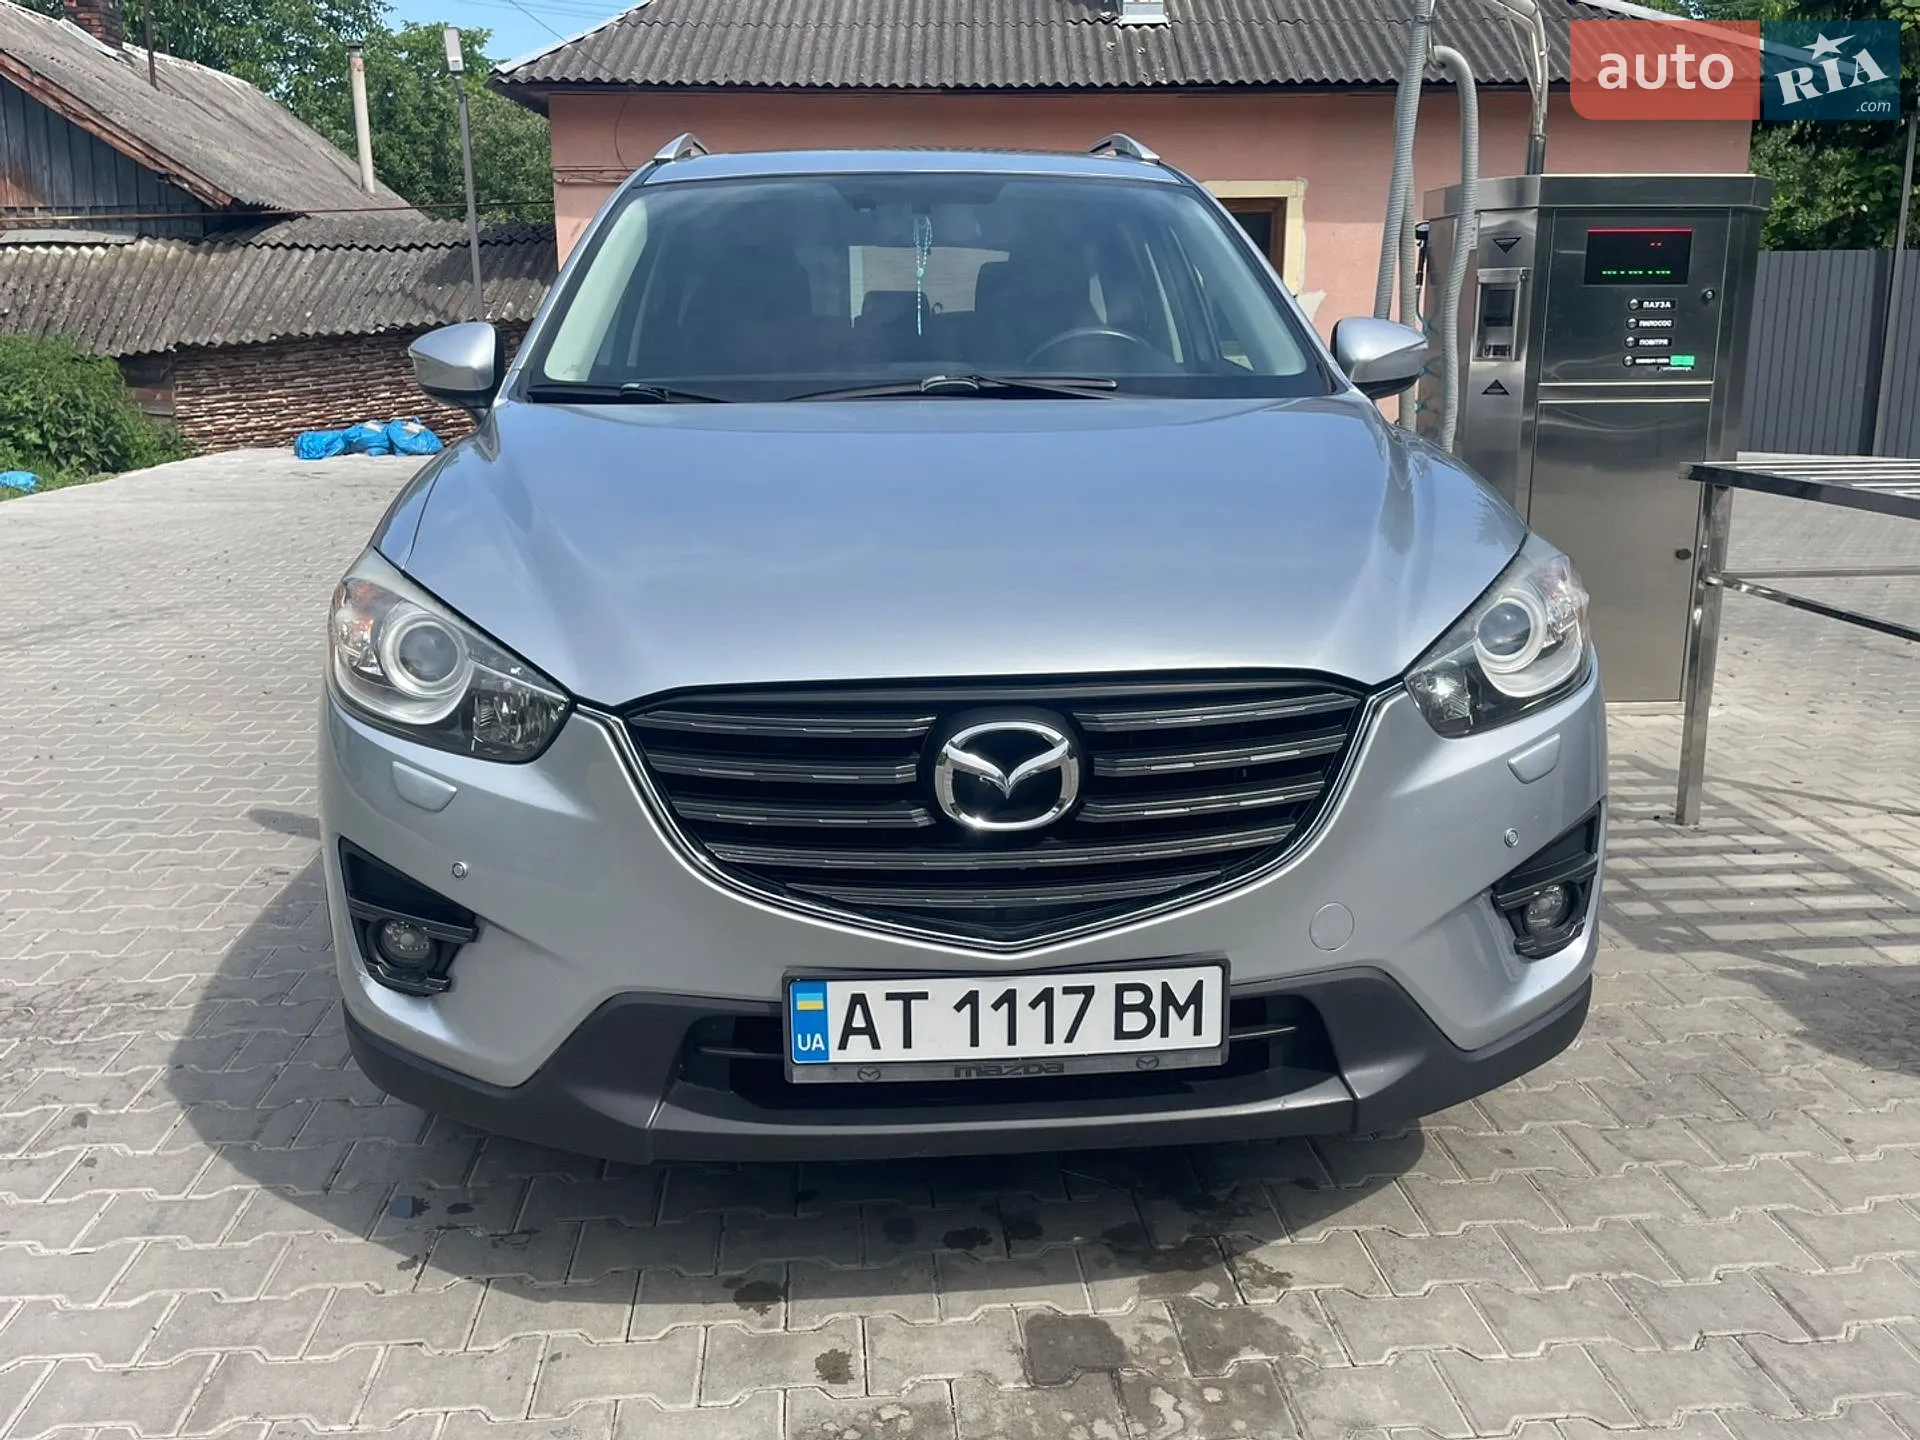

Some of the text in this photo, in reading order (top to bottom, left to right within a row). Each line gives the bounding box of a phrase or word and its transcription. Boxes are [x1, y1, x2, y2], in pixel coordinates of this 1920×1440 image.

[837, 979, 1205, 1051] AT 1117 BM
[797, 1033, 825, 1052] UA
